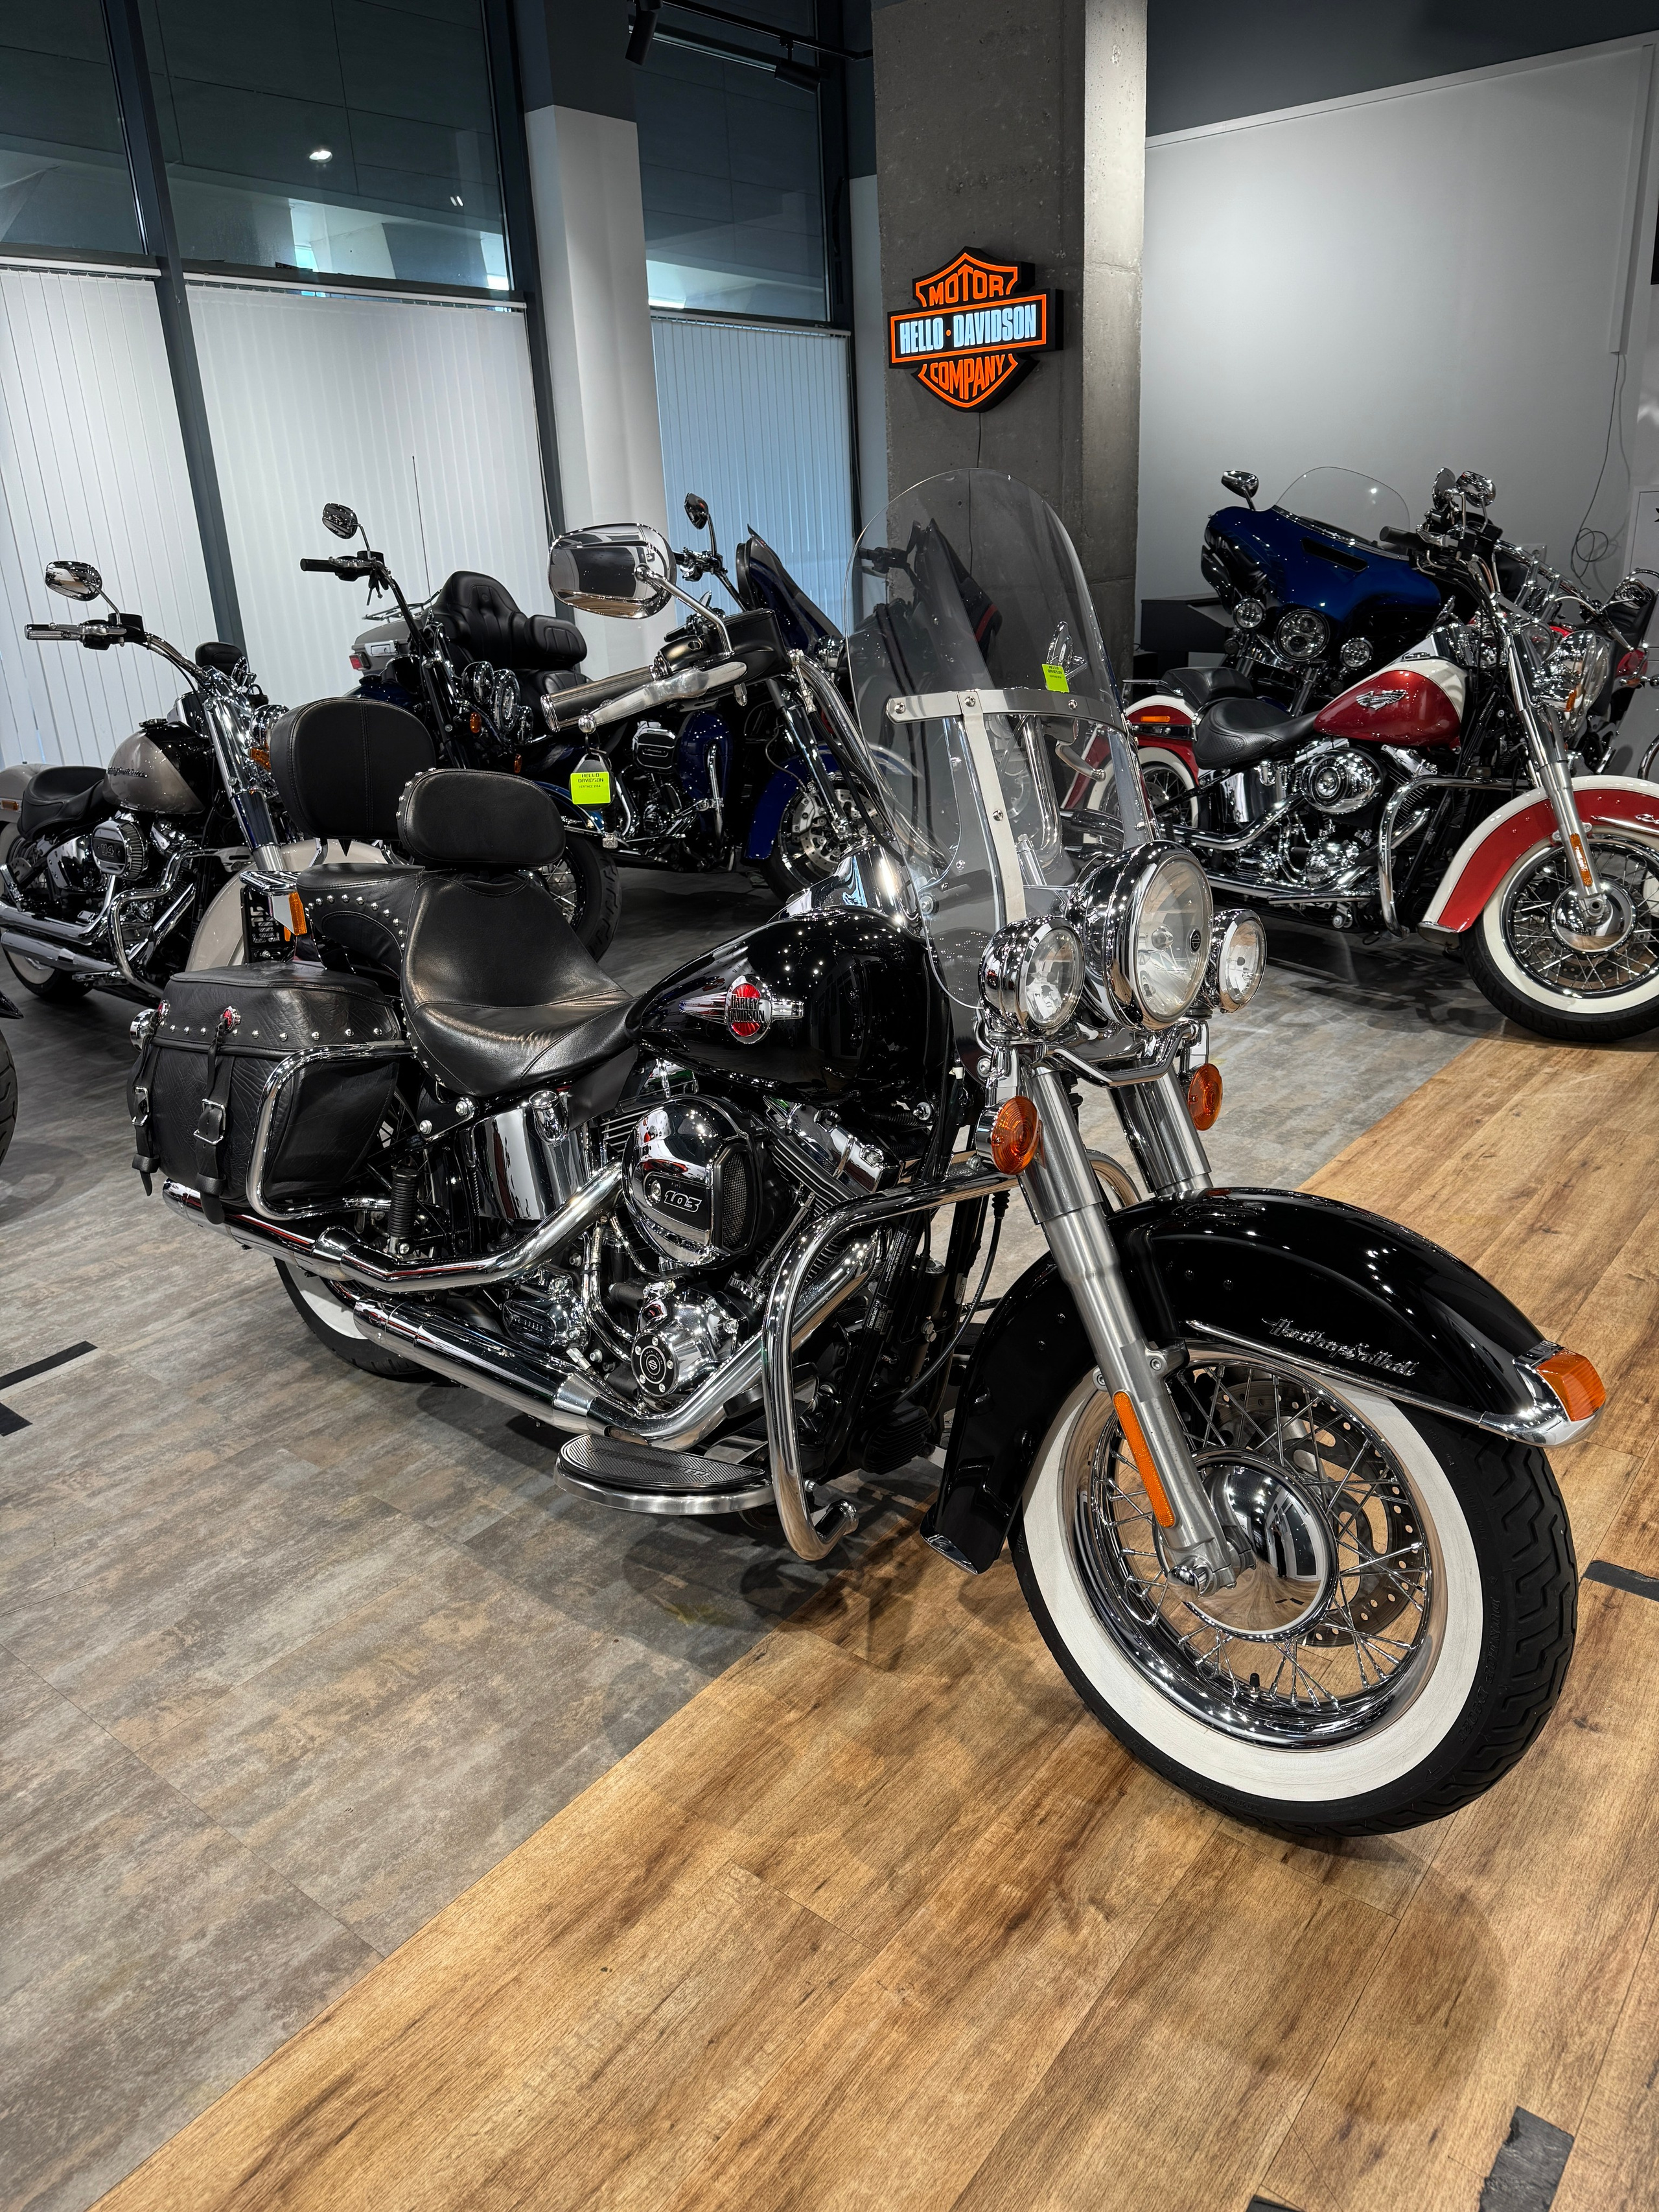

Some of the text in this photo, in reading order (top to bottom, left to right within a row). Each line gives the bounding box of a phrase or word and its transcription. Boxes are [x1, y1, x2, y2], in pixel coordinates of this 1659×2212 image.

[929, 264, 1004, 307] MOTOR
[899, 304, 1036, 355] HELLO DAVIDSON
[930, 353, 1005, 401] COMPANY
[101, 843, 115, 856] 114
[728, 1010, 765, 1023] DAVIDSON
[664, 1190, 702, 1213] 103
